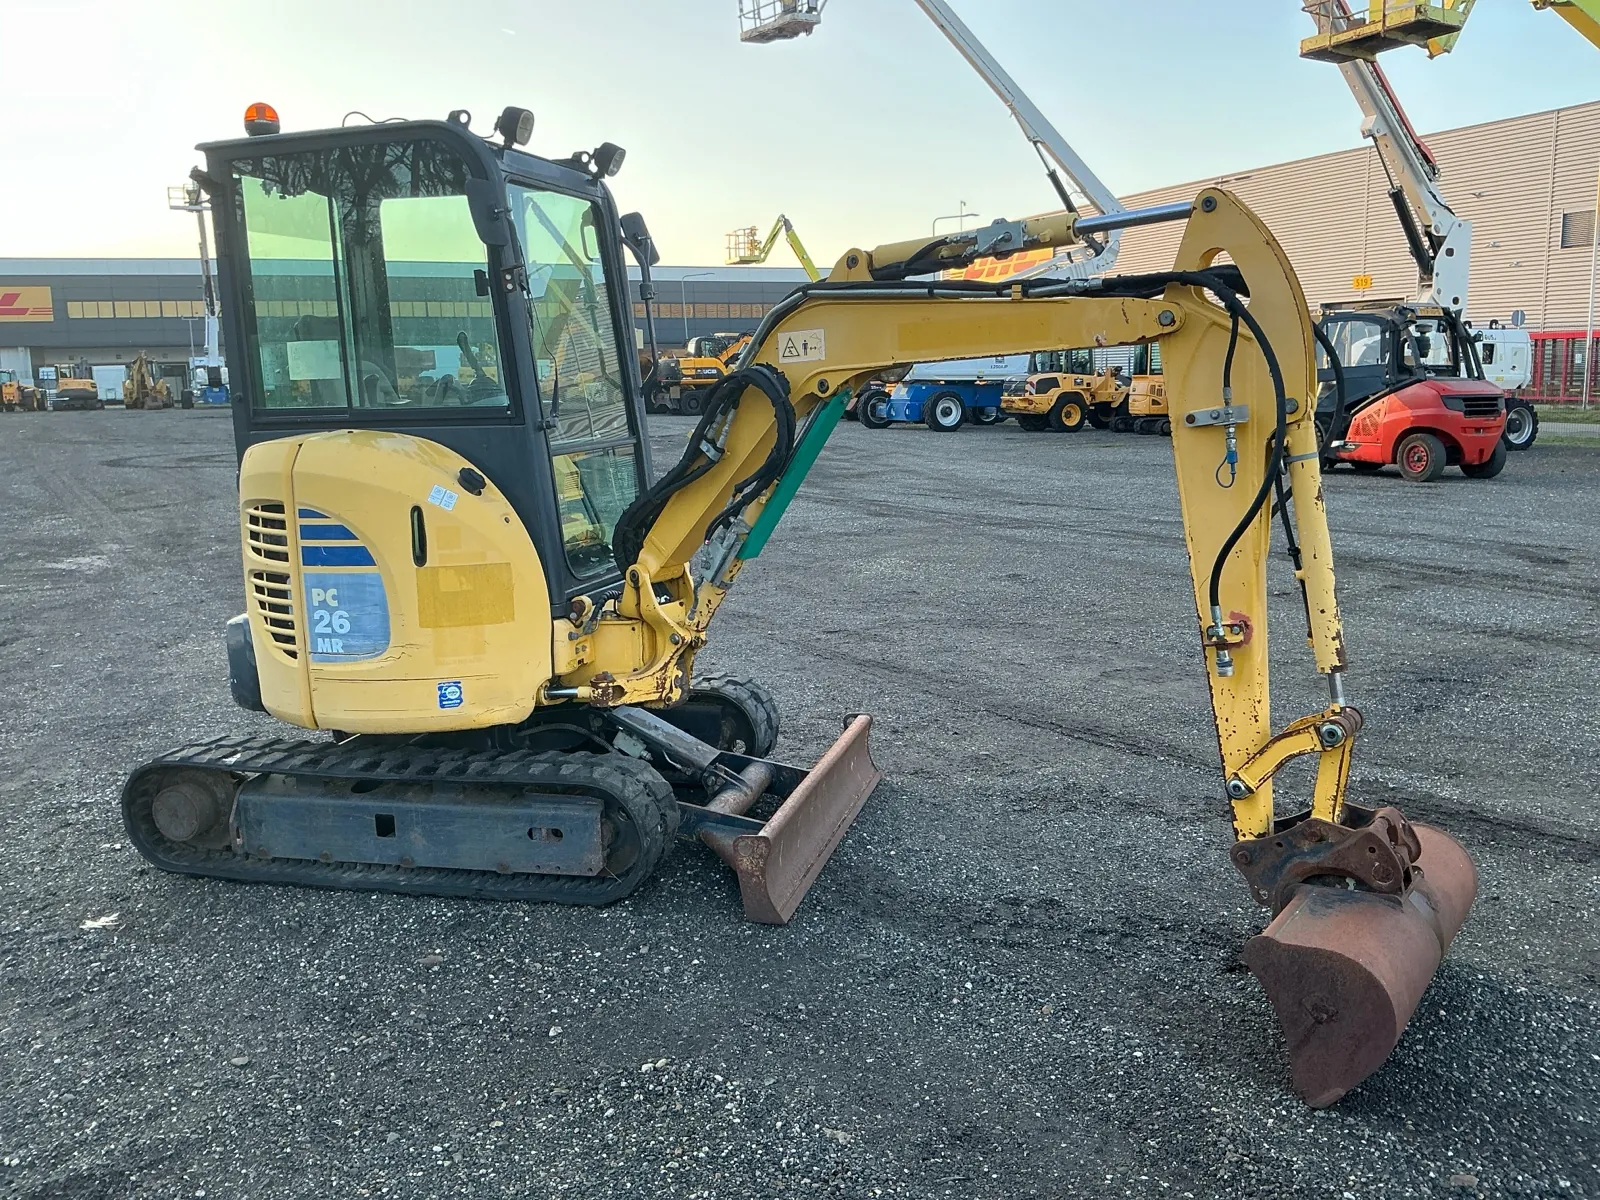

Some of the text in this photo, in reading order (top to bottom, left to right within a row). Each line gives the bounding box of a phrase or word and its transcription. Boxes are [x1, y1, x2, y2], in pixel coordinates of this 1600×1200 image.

[311, 588, 339, 607] PC
[313, 609, 351, 634] 26
[317, 637, 345, 653] MR
